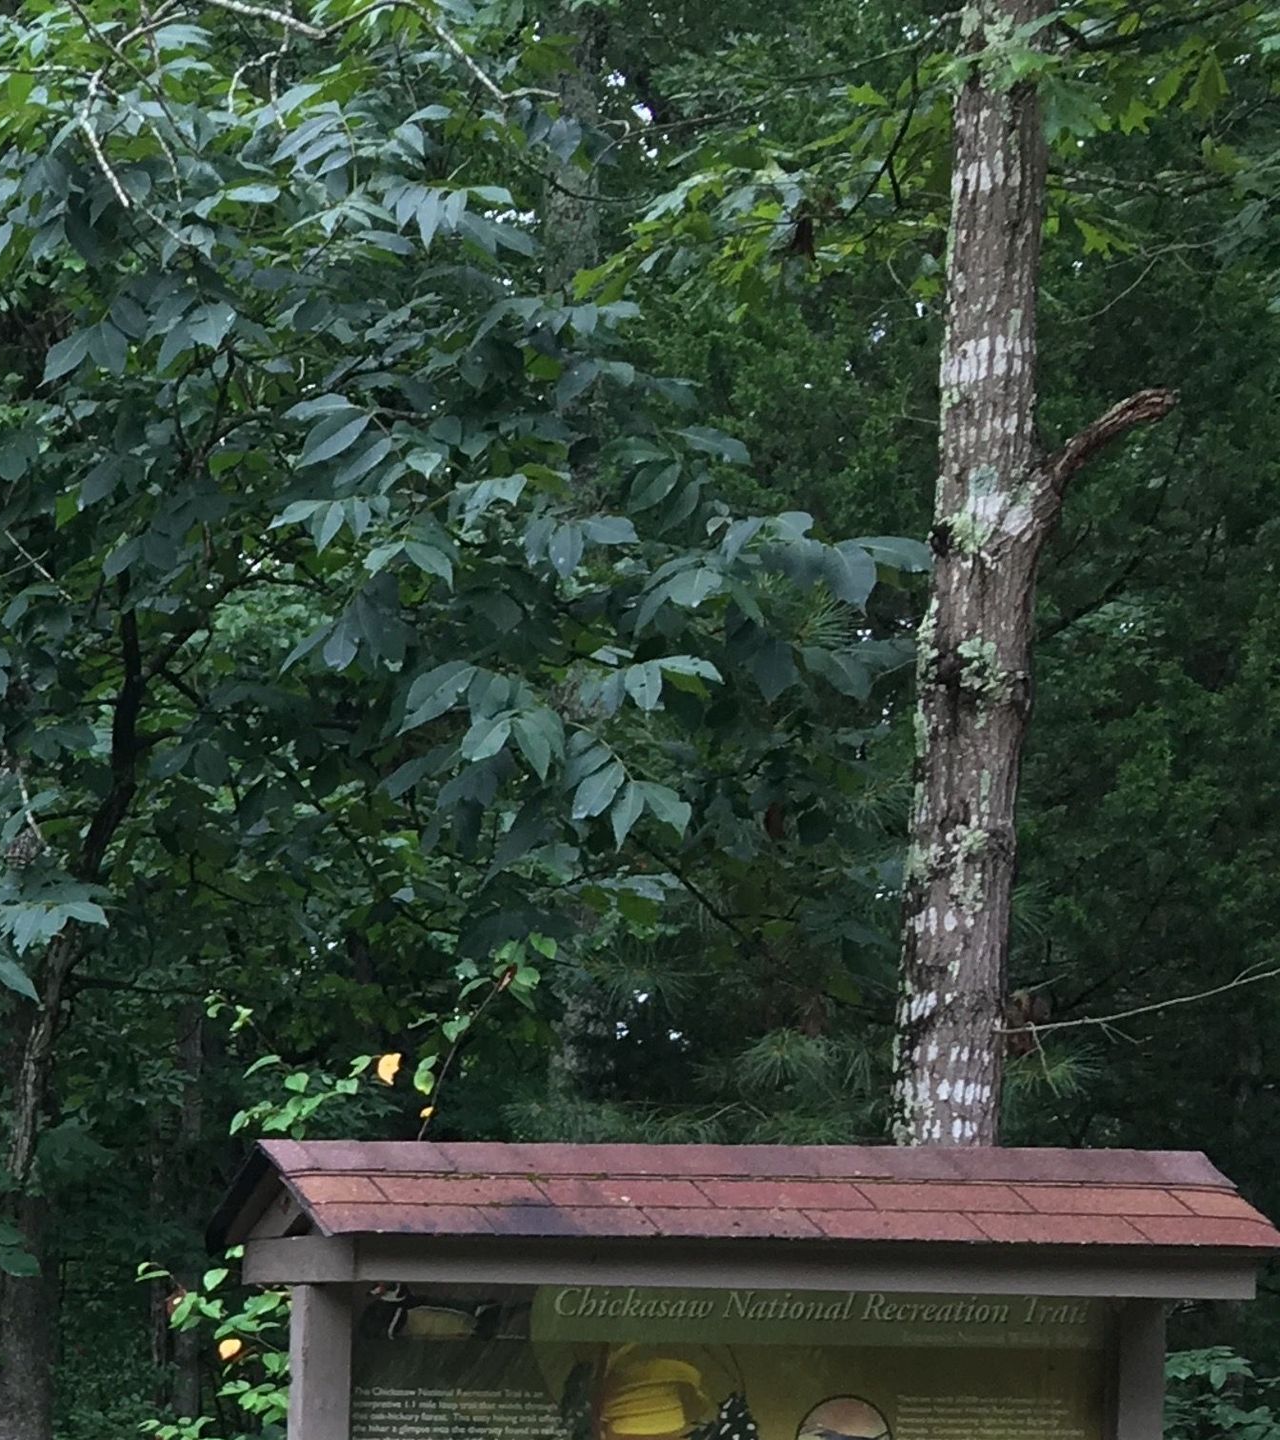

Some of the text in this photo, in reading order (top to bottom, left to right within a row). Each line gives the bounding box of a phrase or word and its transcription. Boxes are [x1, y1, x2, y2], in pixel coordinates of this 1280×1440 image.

[553, 1286, 1088, 1325] Chickasaw National Recreation Trail
